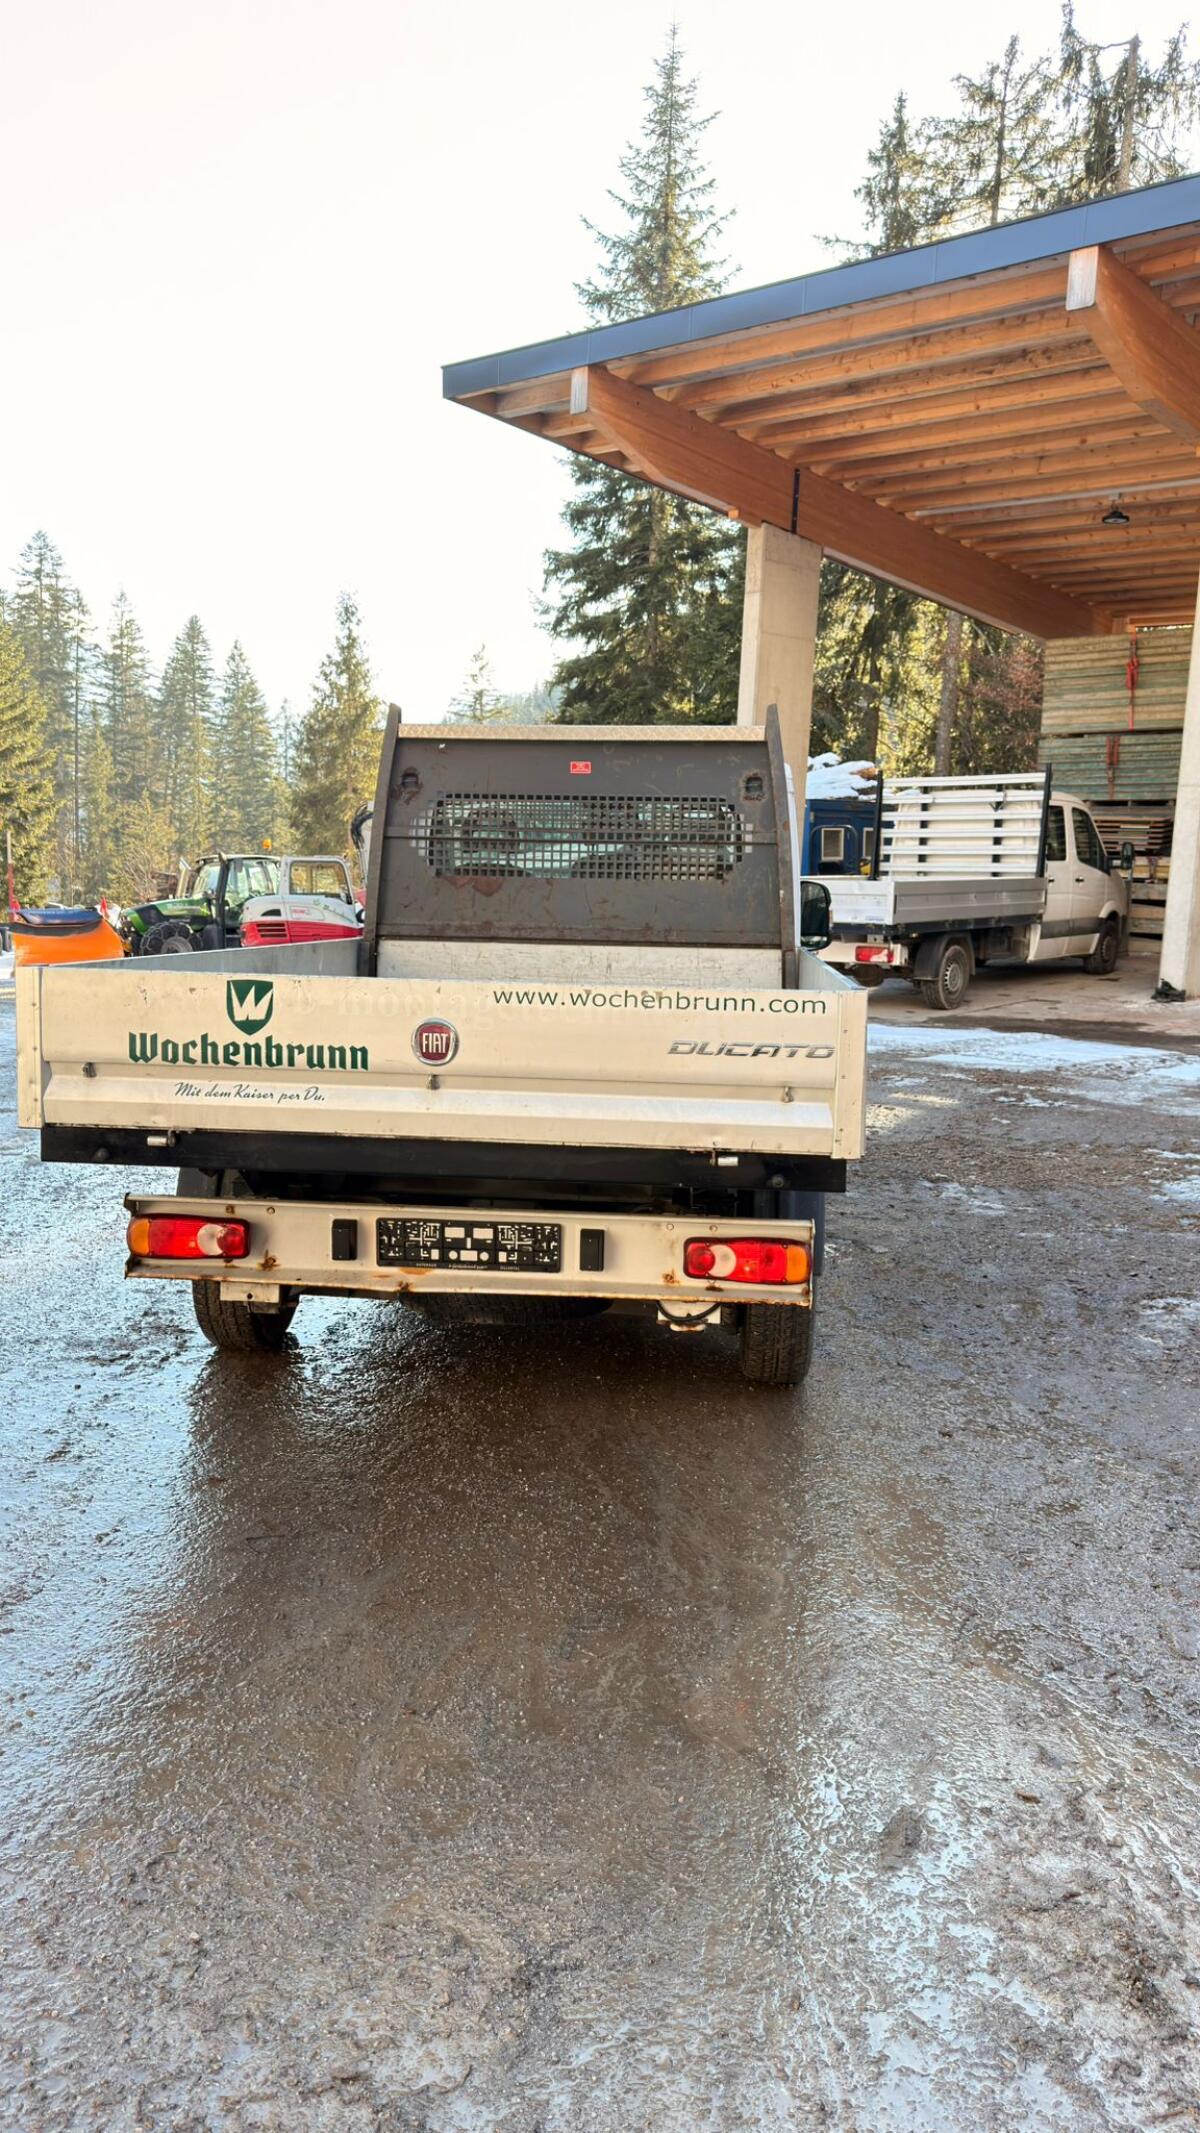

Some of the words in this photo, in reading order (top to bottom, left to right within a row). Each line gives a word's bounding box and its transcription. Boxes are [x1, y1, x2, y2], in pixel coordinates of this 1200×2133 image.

[493, 989, 827, 1014] www.wochenbrunn.com
[128, 1032, 369, 1071] Wochenbrunn
[422, 1032, 449, 1053] FIAT
[667, 1040, 835, 1059] DUCATO
[175, 1081, 201, 1097] Mit
[204, 1083, 231, 1098] dem
[234, 1084, 274, 1099] Kaiser
[277, 1091, 300, 1104] per
[303, 1086, 326, 1101] Du.
